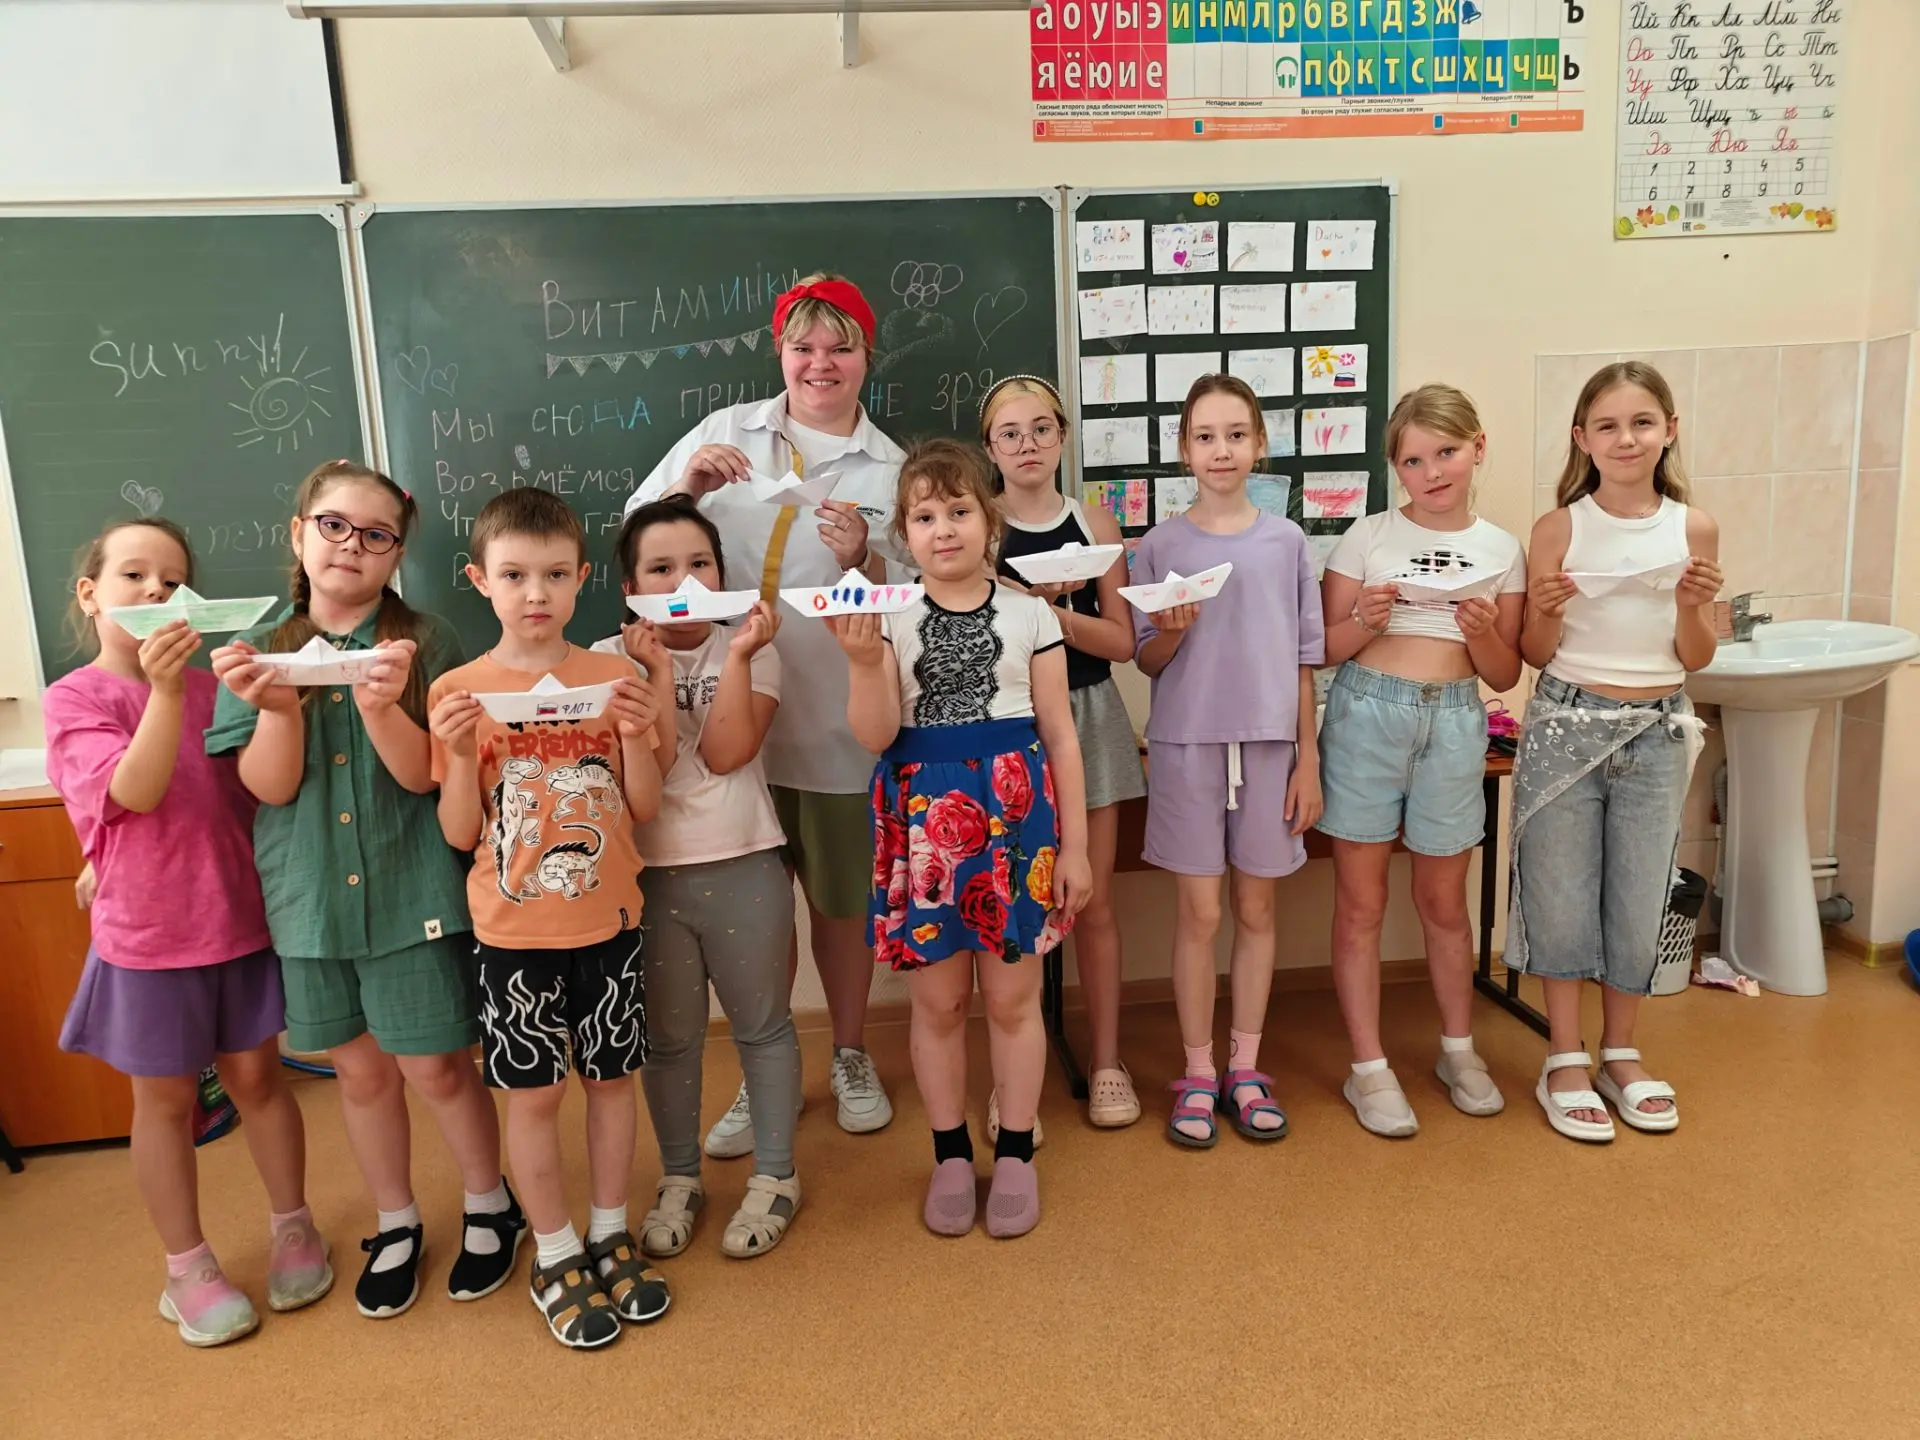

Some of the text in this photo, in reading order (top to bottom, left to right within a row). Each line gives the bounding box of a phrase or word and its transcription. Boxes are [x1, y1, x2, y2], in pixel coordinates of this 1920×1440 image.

[1037, 61, 1056, 89] я
[1064, 51, 1081, 89] ё
[1089, 61, 1112, 88] ю
[1119, 61, 1136, 88] и
[1146, 61, 1163, 88] е
[1304, 60, 1321, 85] п
[1328, 50, 1350, 95] ф
[1357, 58, 1374, 84] к
[1384, 58, 1400, 84] т
[1411, 58, 1424, 84] с
[1434, 56, 1456, 82] ш
[1463, 55, 1478, 81] х
[1486, 56, 1503, 88] ц
[1513, 55, 1529, 80] ч
[1535, 54, 1556, 87] щ
[1649, 158, 1804, 177] 1 2 3 4 5
[1649, 182, 1803, 201] 6 7 8 9 0
